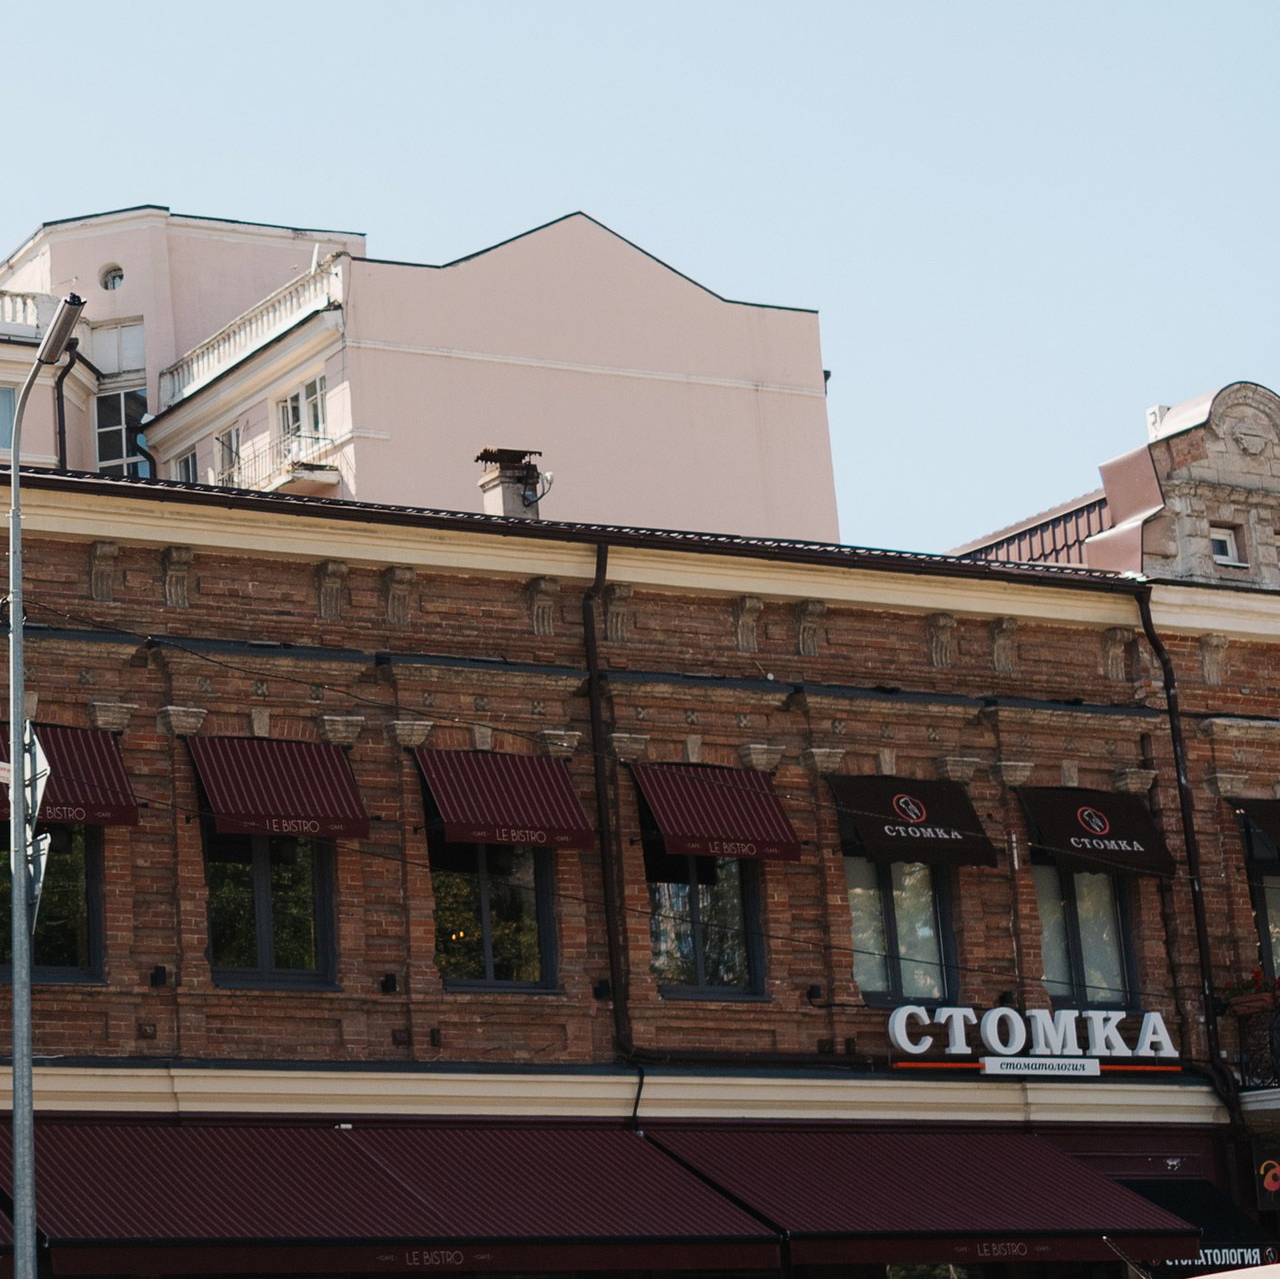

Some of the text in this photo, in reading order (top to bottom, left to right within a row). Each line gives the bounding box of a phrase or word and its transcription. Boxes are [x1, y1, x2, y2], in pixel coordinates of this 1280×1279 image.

[46, 806, 86, 820] BISTRO
[282, 819, 320, 833] BISTRO
[884, 825, 963, 840] СТОМКА
[496, 828, 508, 841] LE
[510, 829, 547, 843] BISTRO
[708, 842, 721, 853] LE
[722, 842, 757, 855] BISTRO
[1070, 836, 1145, 852] СТОМКА
[888, 1005, 1179, 1057] СТОМКА
[999, 1060, 1086, 1072] стоматология
[977, 1243, 991, 1257] LE
[992, 1242, 1028, 1256] BISTRO
[405, 1251, 420, 1265] LE
[423, 1250, 464, 1265] BISTRO
